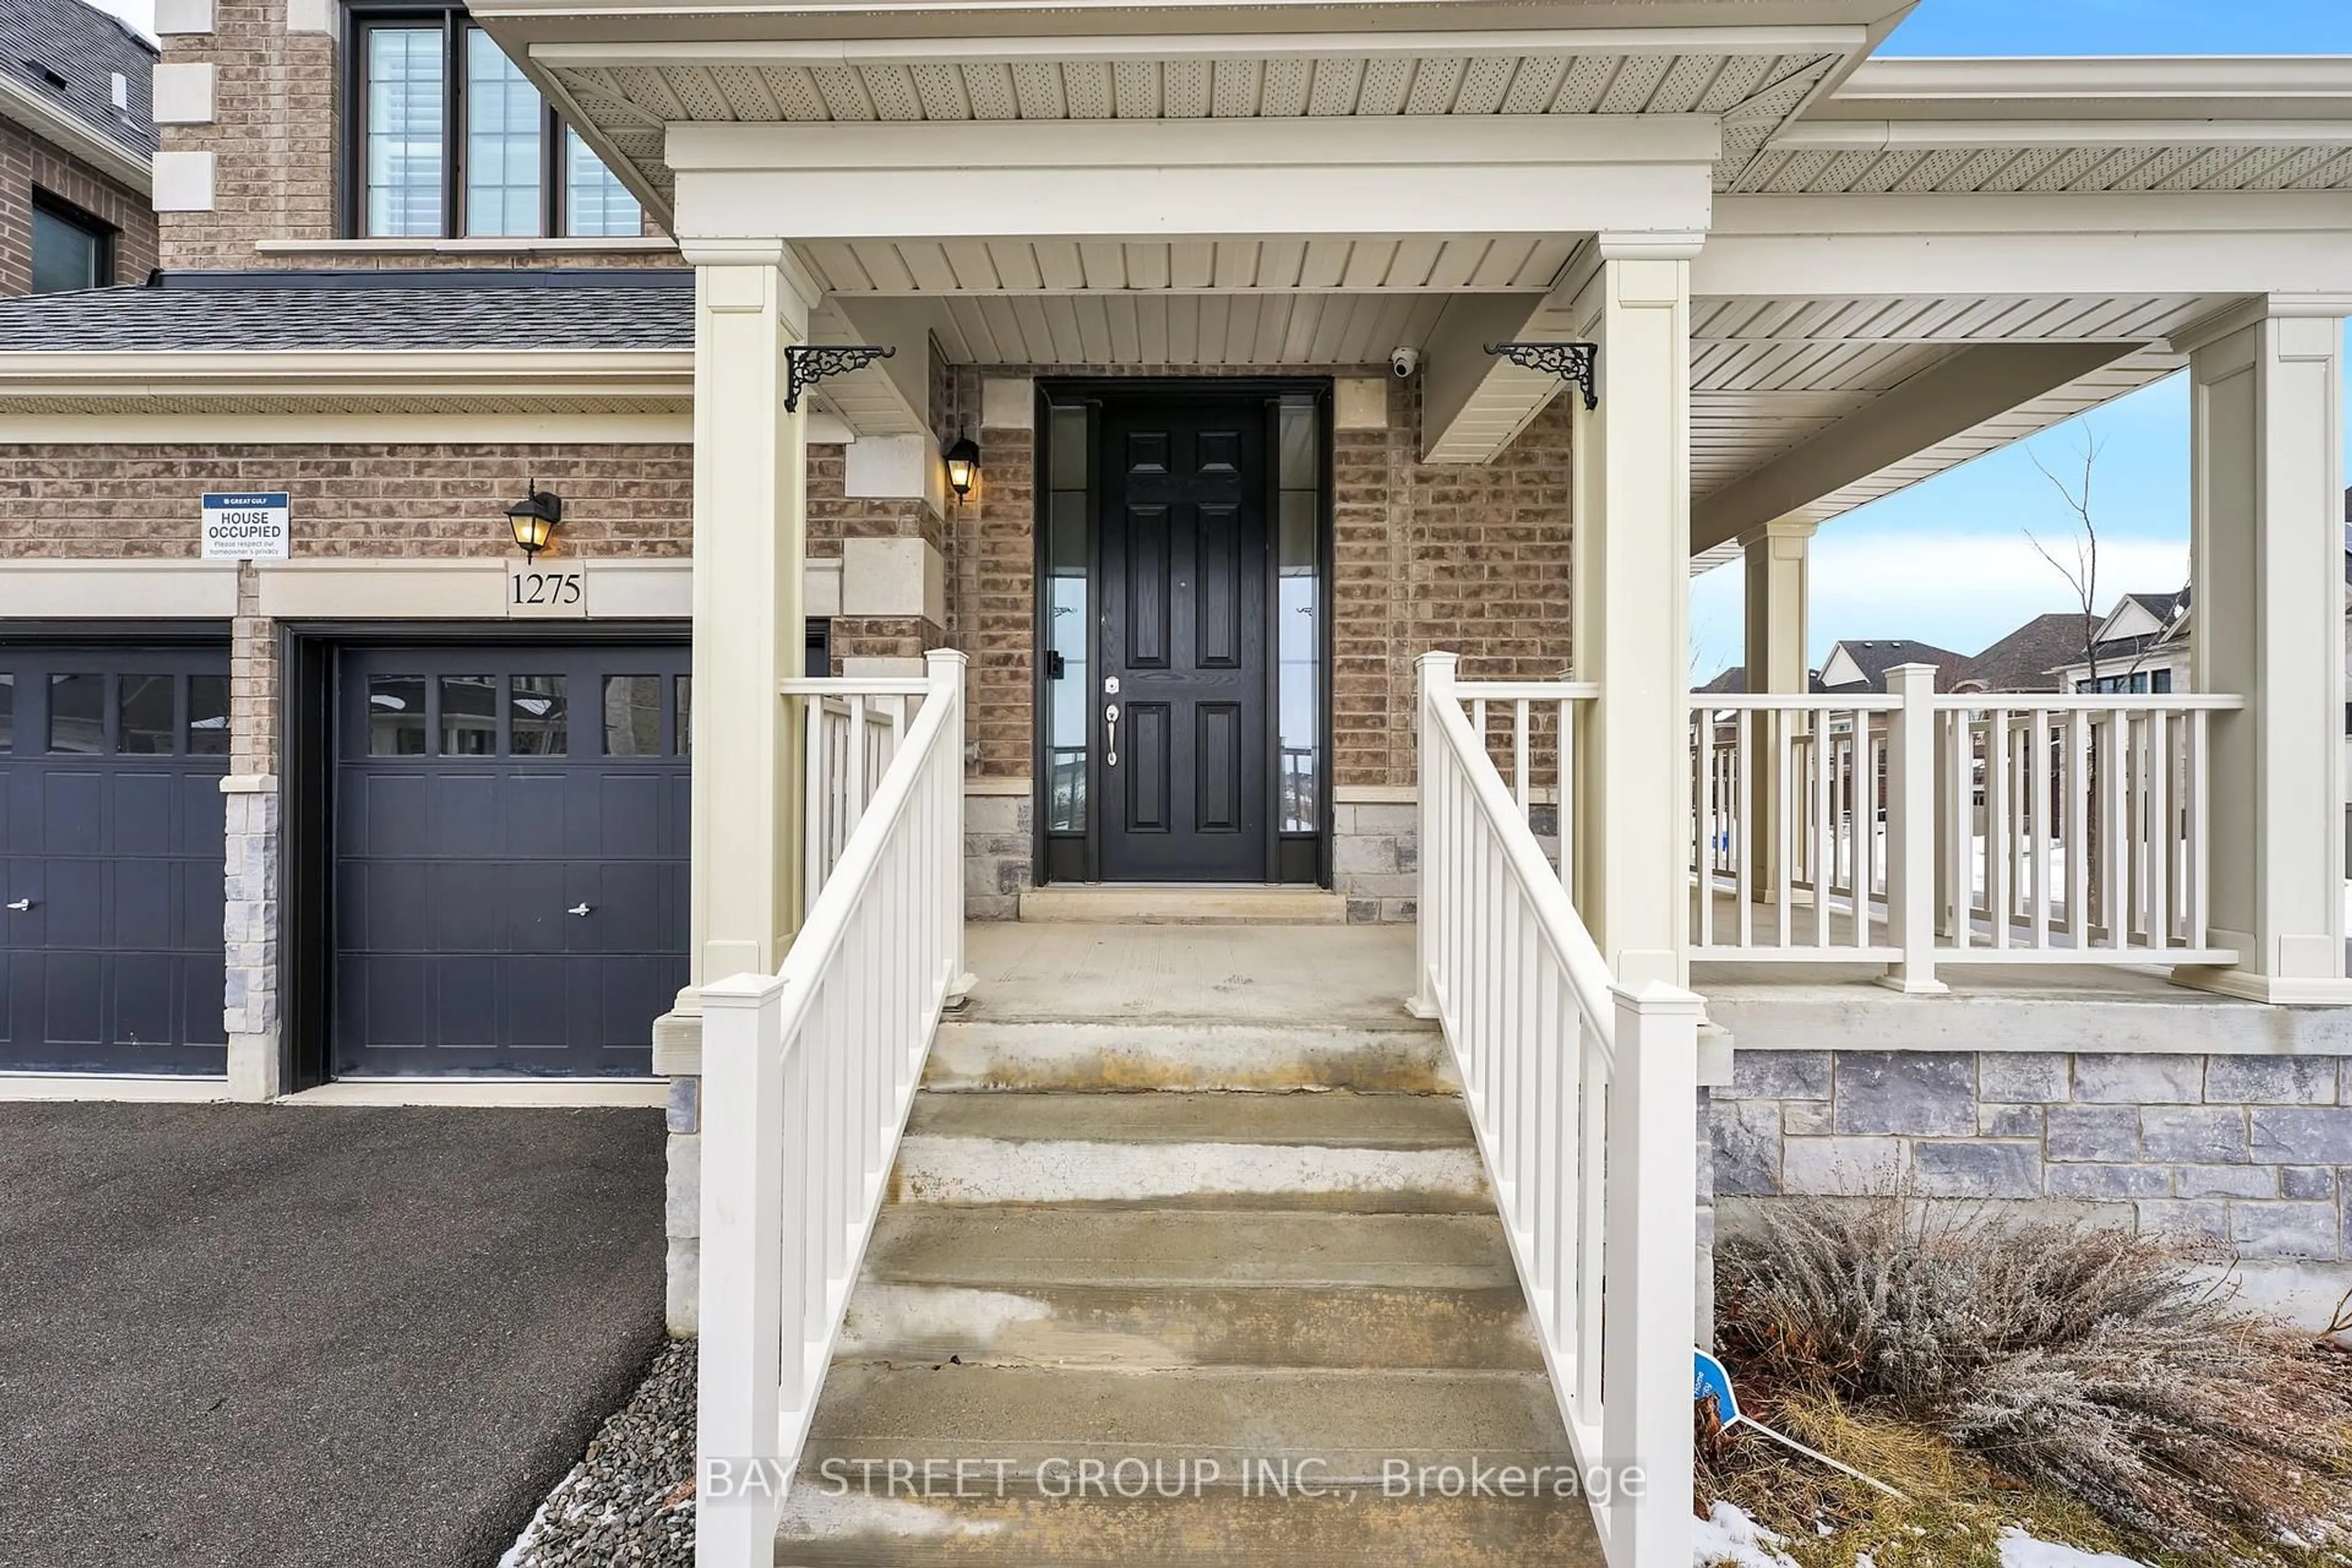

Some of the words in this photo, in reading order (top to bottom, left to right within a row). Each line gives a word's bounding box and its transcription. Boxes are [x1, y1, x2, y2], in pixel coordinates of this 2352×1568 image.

[221, 512, 269, 524] HOUSE
[209, 526, 281, 538] OCCUPIED
[512, 574, 580, 604] 1275
